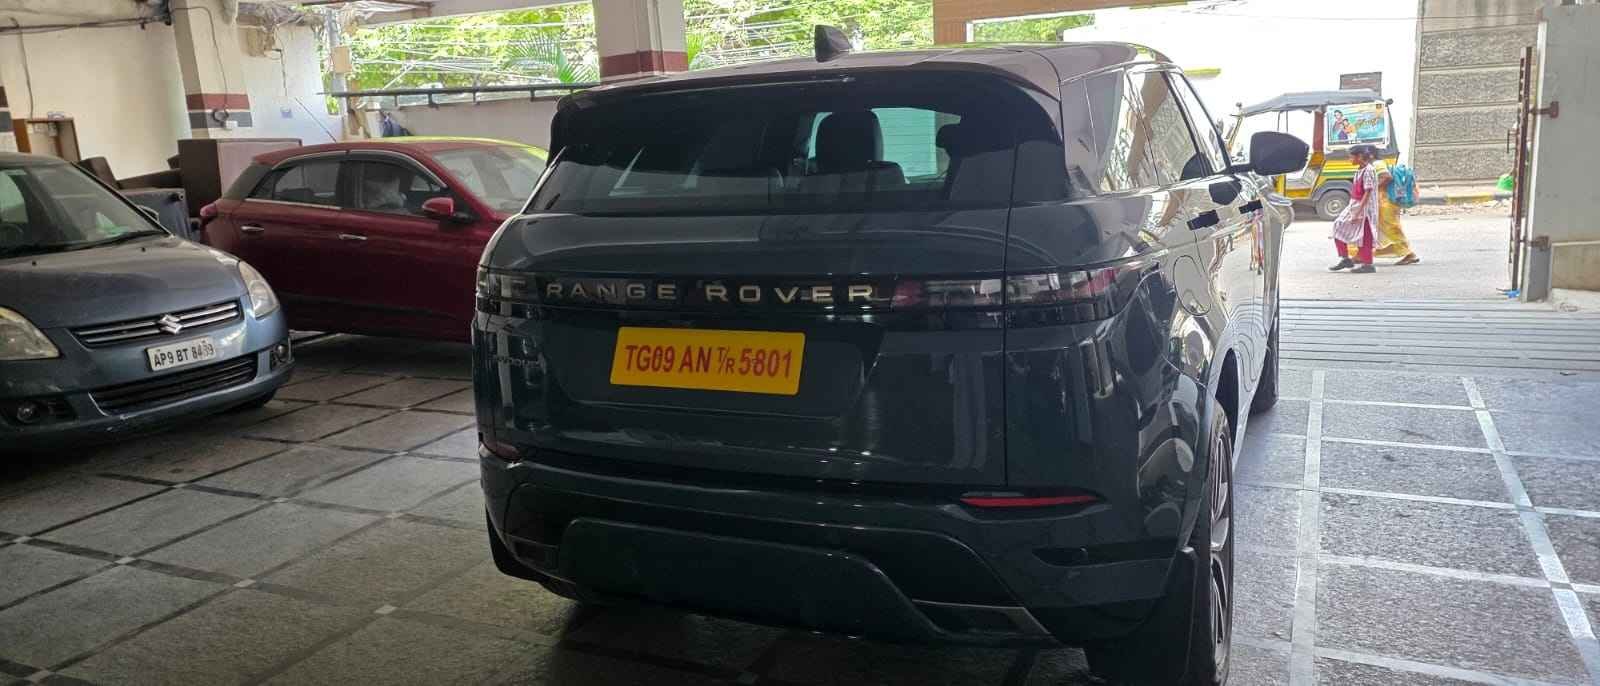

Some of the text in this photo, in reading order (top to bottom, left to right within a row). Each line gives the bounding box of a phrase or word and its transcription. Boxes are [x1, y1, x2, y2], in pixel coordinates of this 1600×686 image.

[545, 283, 876, 303] RANGE ROVER
[176, 347, 189, 362] BT
[625, 345, 675, 373] TG09
[678, 346, 713, 374] AN
[738, 347, 793, 380] 5801
